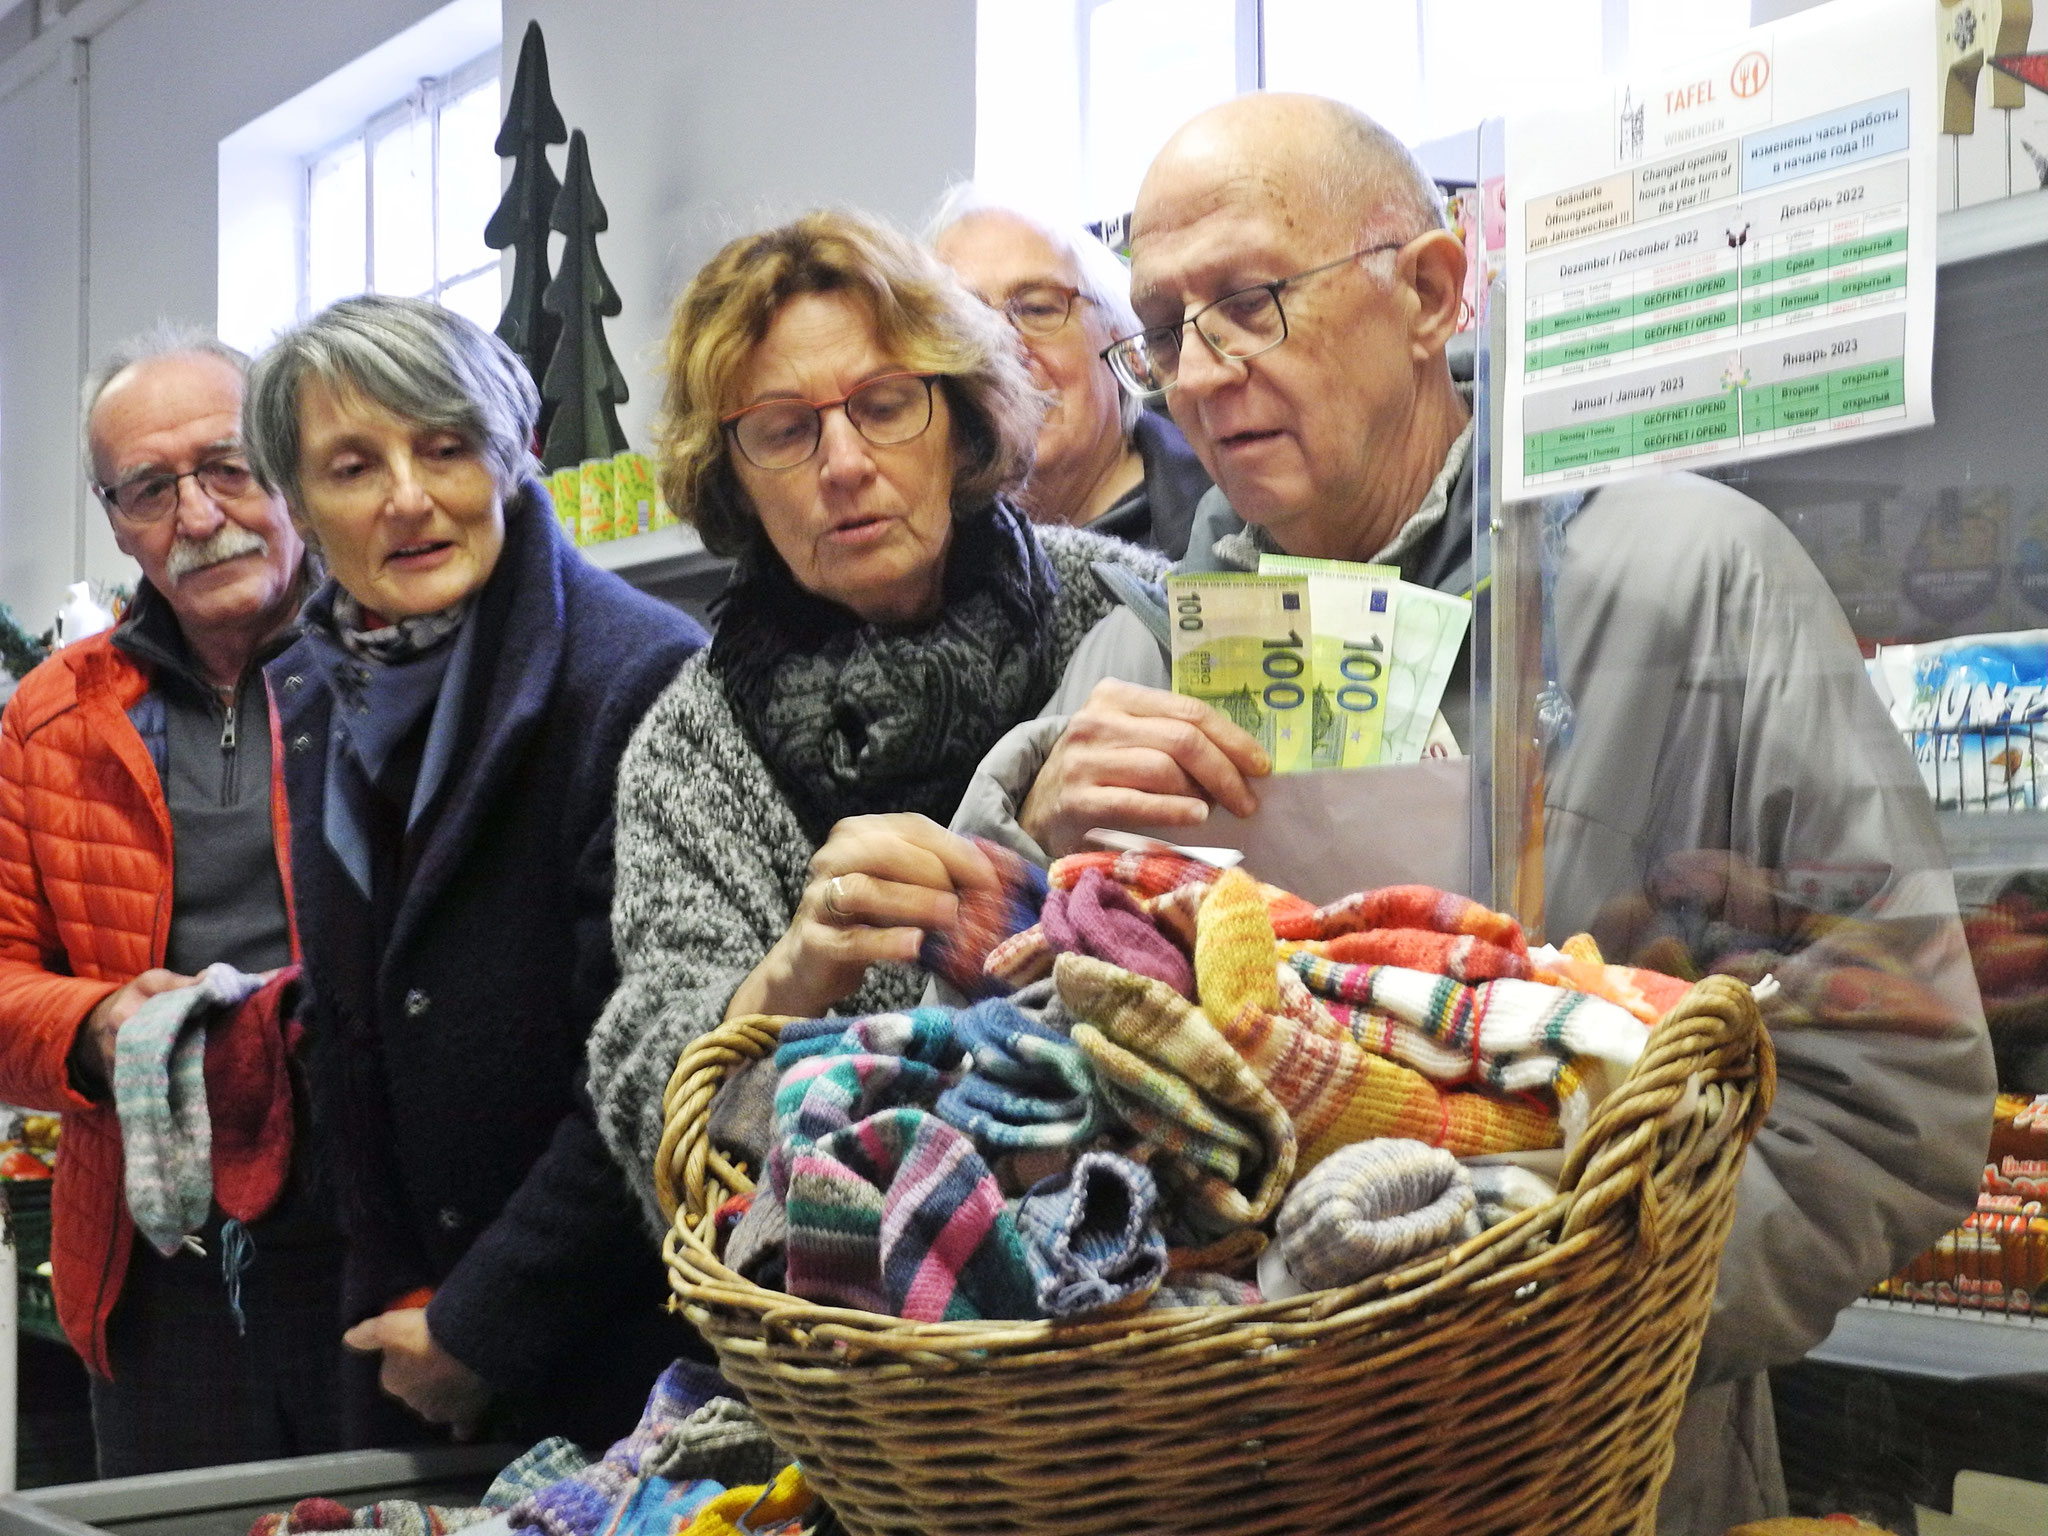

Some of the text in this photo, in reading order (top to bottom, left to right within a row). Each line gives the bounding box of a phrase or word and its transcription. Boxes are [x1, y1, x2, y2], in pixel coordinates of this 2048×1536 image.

[1665, 80, 1716, 115] TAFEL
[1664, 118, 1725, 147] WINNENDEN
[1751, 109, 1898, 159] изменены часы работы
[1642, 150, 1727, 182] Changed opening
[1773, 163, 1780, 173] в
[1784, 151, 1826, 170] начале
[1831, 141, 1858, 157] года
[1556, 187, 1602, 207] Geänderte
[1639, 164, 1731, 201] hours at the turn of
[1545, 201, 1613, 227] Öffnungszeiten
[1659, 202, 1673, 213] the
[1676, 195, 1696, 212] year
[1780, 187, 1864, 221] Декабрь 2022
[1530, 237, 1548, 249] zum
[1550, 214, 1618, 243] Jahreswechsel
[1560, 257, 1609, 277] Dezember
[1619, 241, 1669, 263] December
[1675, 231, 1698, 247] 2022
[1644, 287, 1688, 307] GEÖFFNET
[1696, 278, 1726, 294] OPEND
[1644, 320, 1688, 340] GEÖFFNET
[1696, 312, 1726, 327] OPEND
[1783, 339, 1858, 367] Январь 2023
[1572, 397, 1606, 411] Januar
[1616, 386, 1655, 402] January
[1661, 377, 1684, 393] 2023
[1644, 407, 1688, 425] GEÖFFNET
[1696, 400, 1726, 415] OPEND
[1644, 430, 1688, 448] GEÖFFNET
[1696, 423, 1727, 437] OPEND
[1177, 591, 1203, 631] 100
[1201, 651, 1211, 685] EURO
[1263, 629, 1304, 710] 100
[1336, 632, 1384, 712] 100
